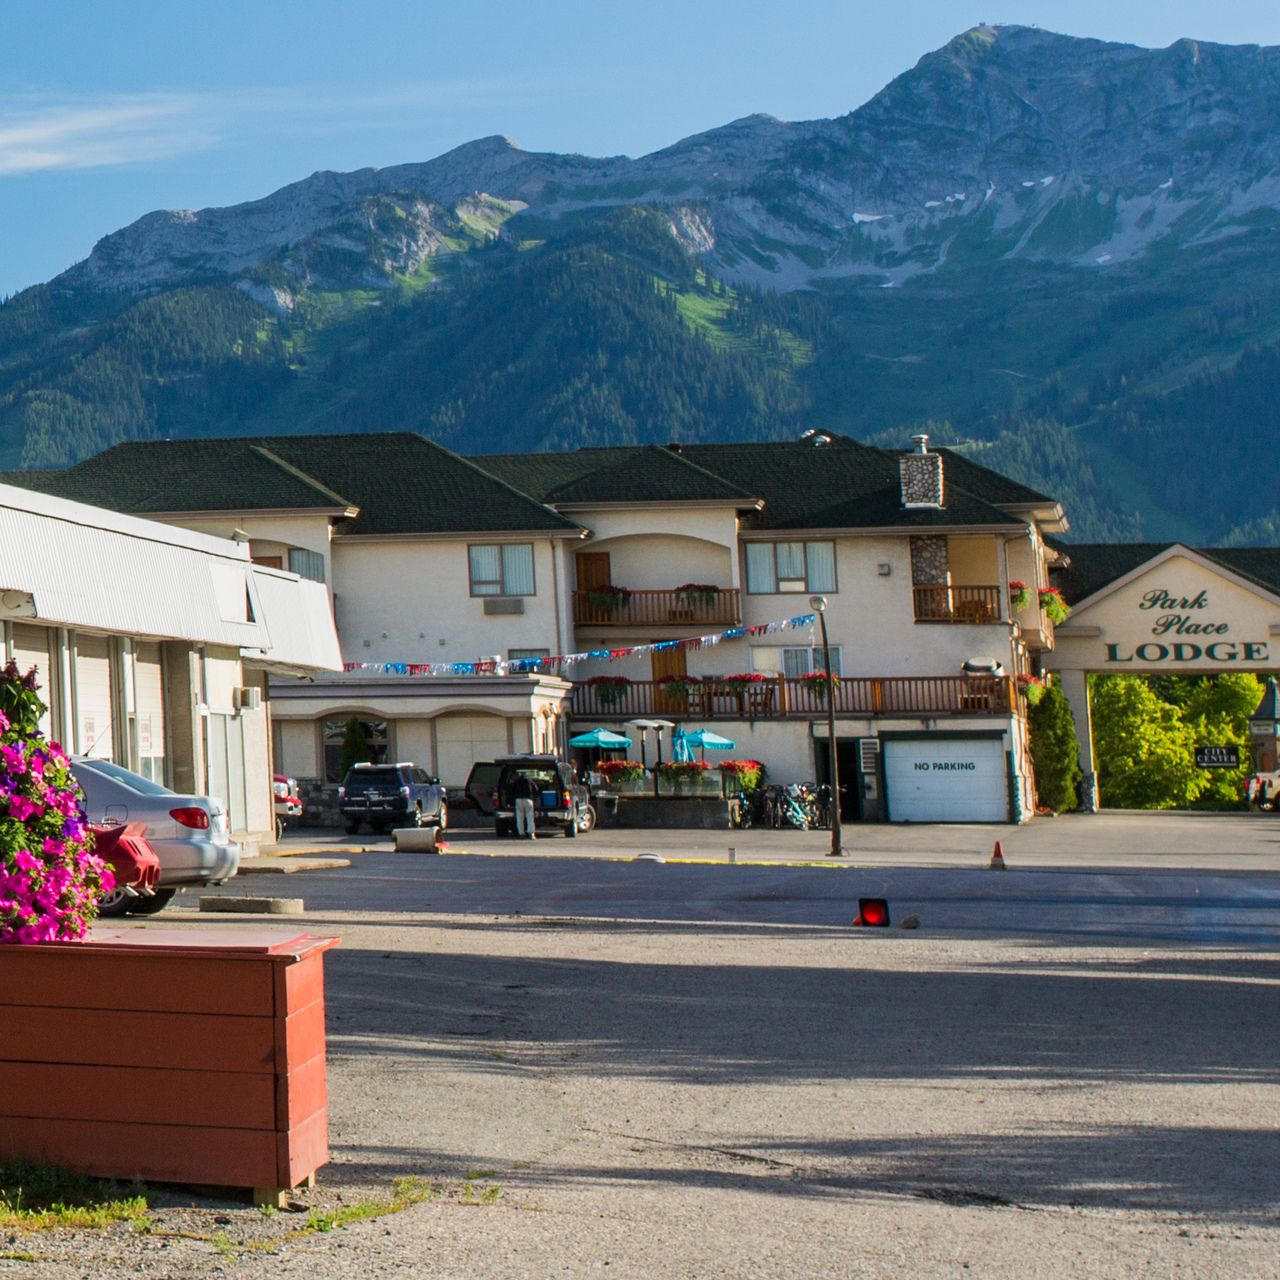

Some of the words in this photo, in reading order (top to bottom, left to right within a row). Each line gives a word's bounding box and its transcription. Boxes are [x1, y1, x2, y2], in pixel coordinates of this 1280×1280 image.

[1139, 589, 1208, 610] Park
[1151, 614, 1229, 635] Place
[1104, 642, 1269, 662] LODGE
[914, 762, 930, 771] NO
[932, 762, 976, 771] PARKING
